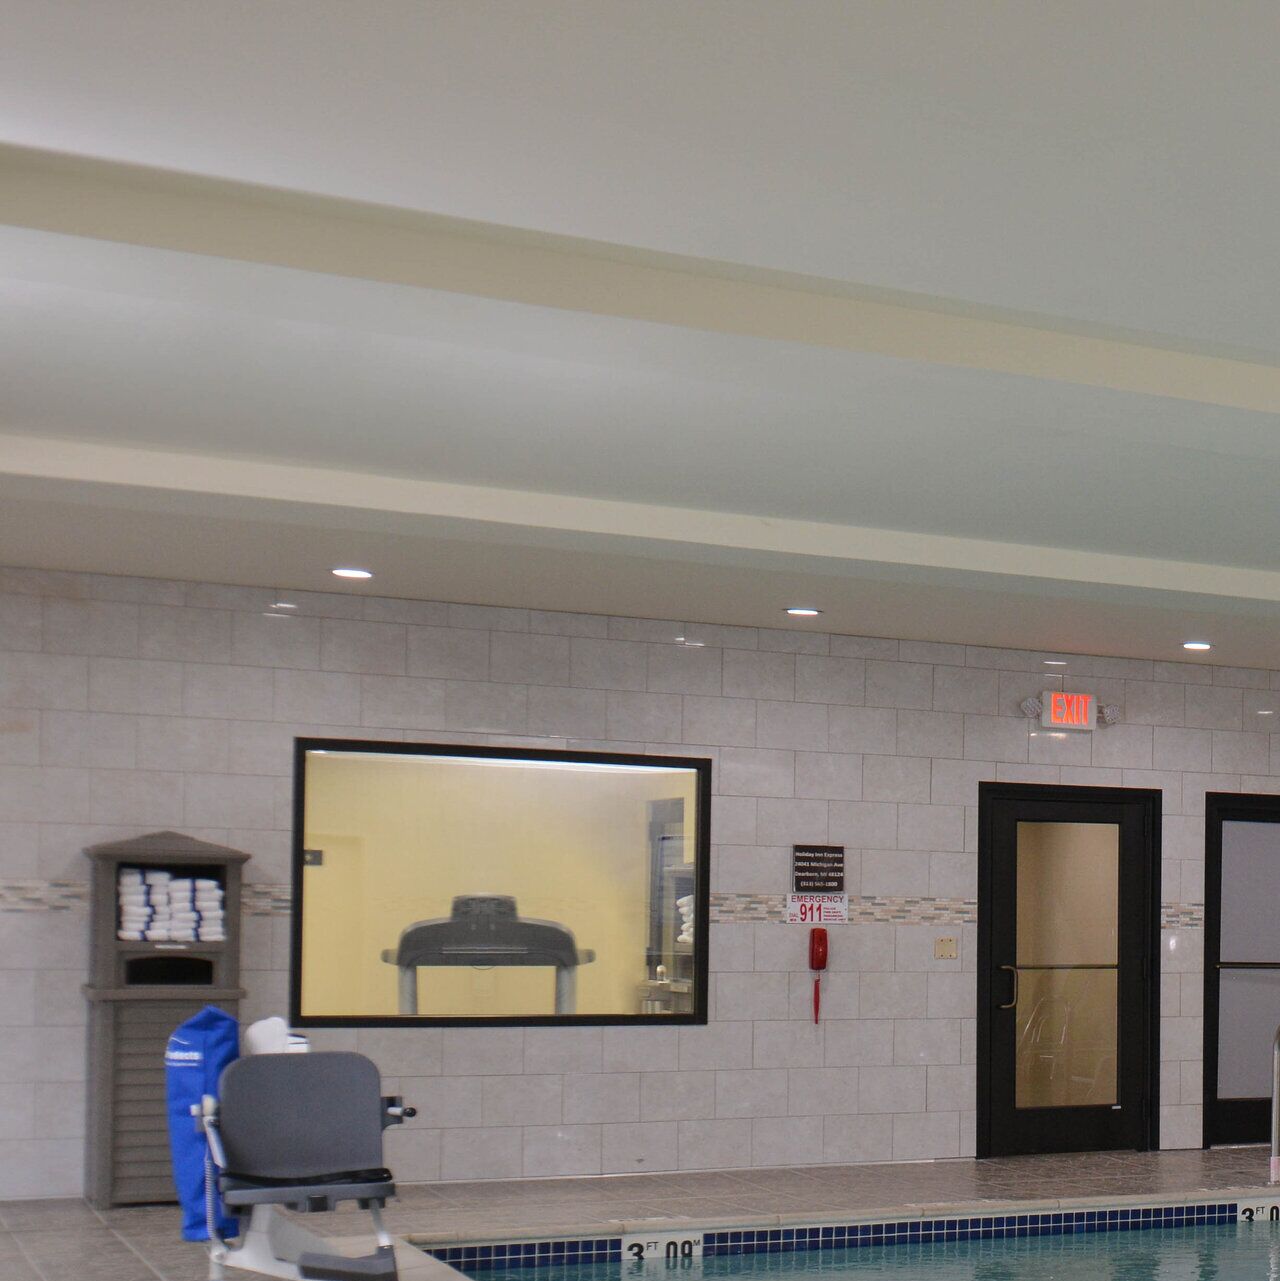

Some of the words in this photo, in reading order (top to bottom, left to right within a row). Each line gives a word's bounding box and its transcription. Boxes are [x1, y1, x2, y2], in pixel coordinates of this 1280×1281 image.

[1051, 692, 1092, 726] EXIT
[791, 895, 844, 903] EMERGENCY
[800, 903, 822, 922] 911
